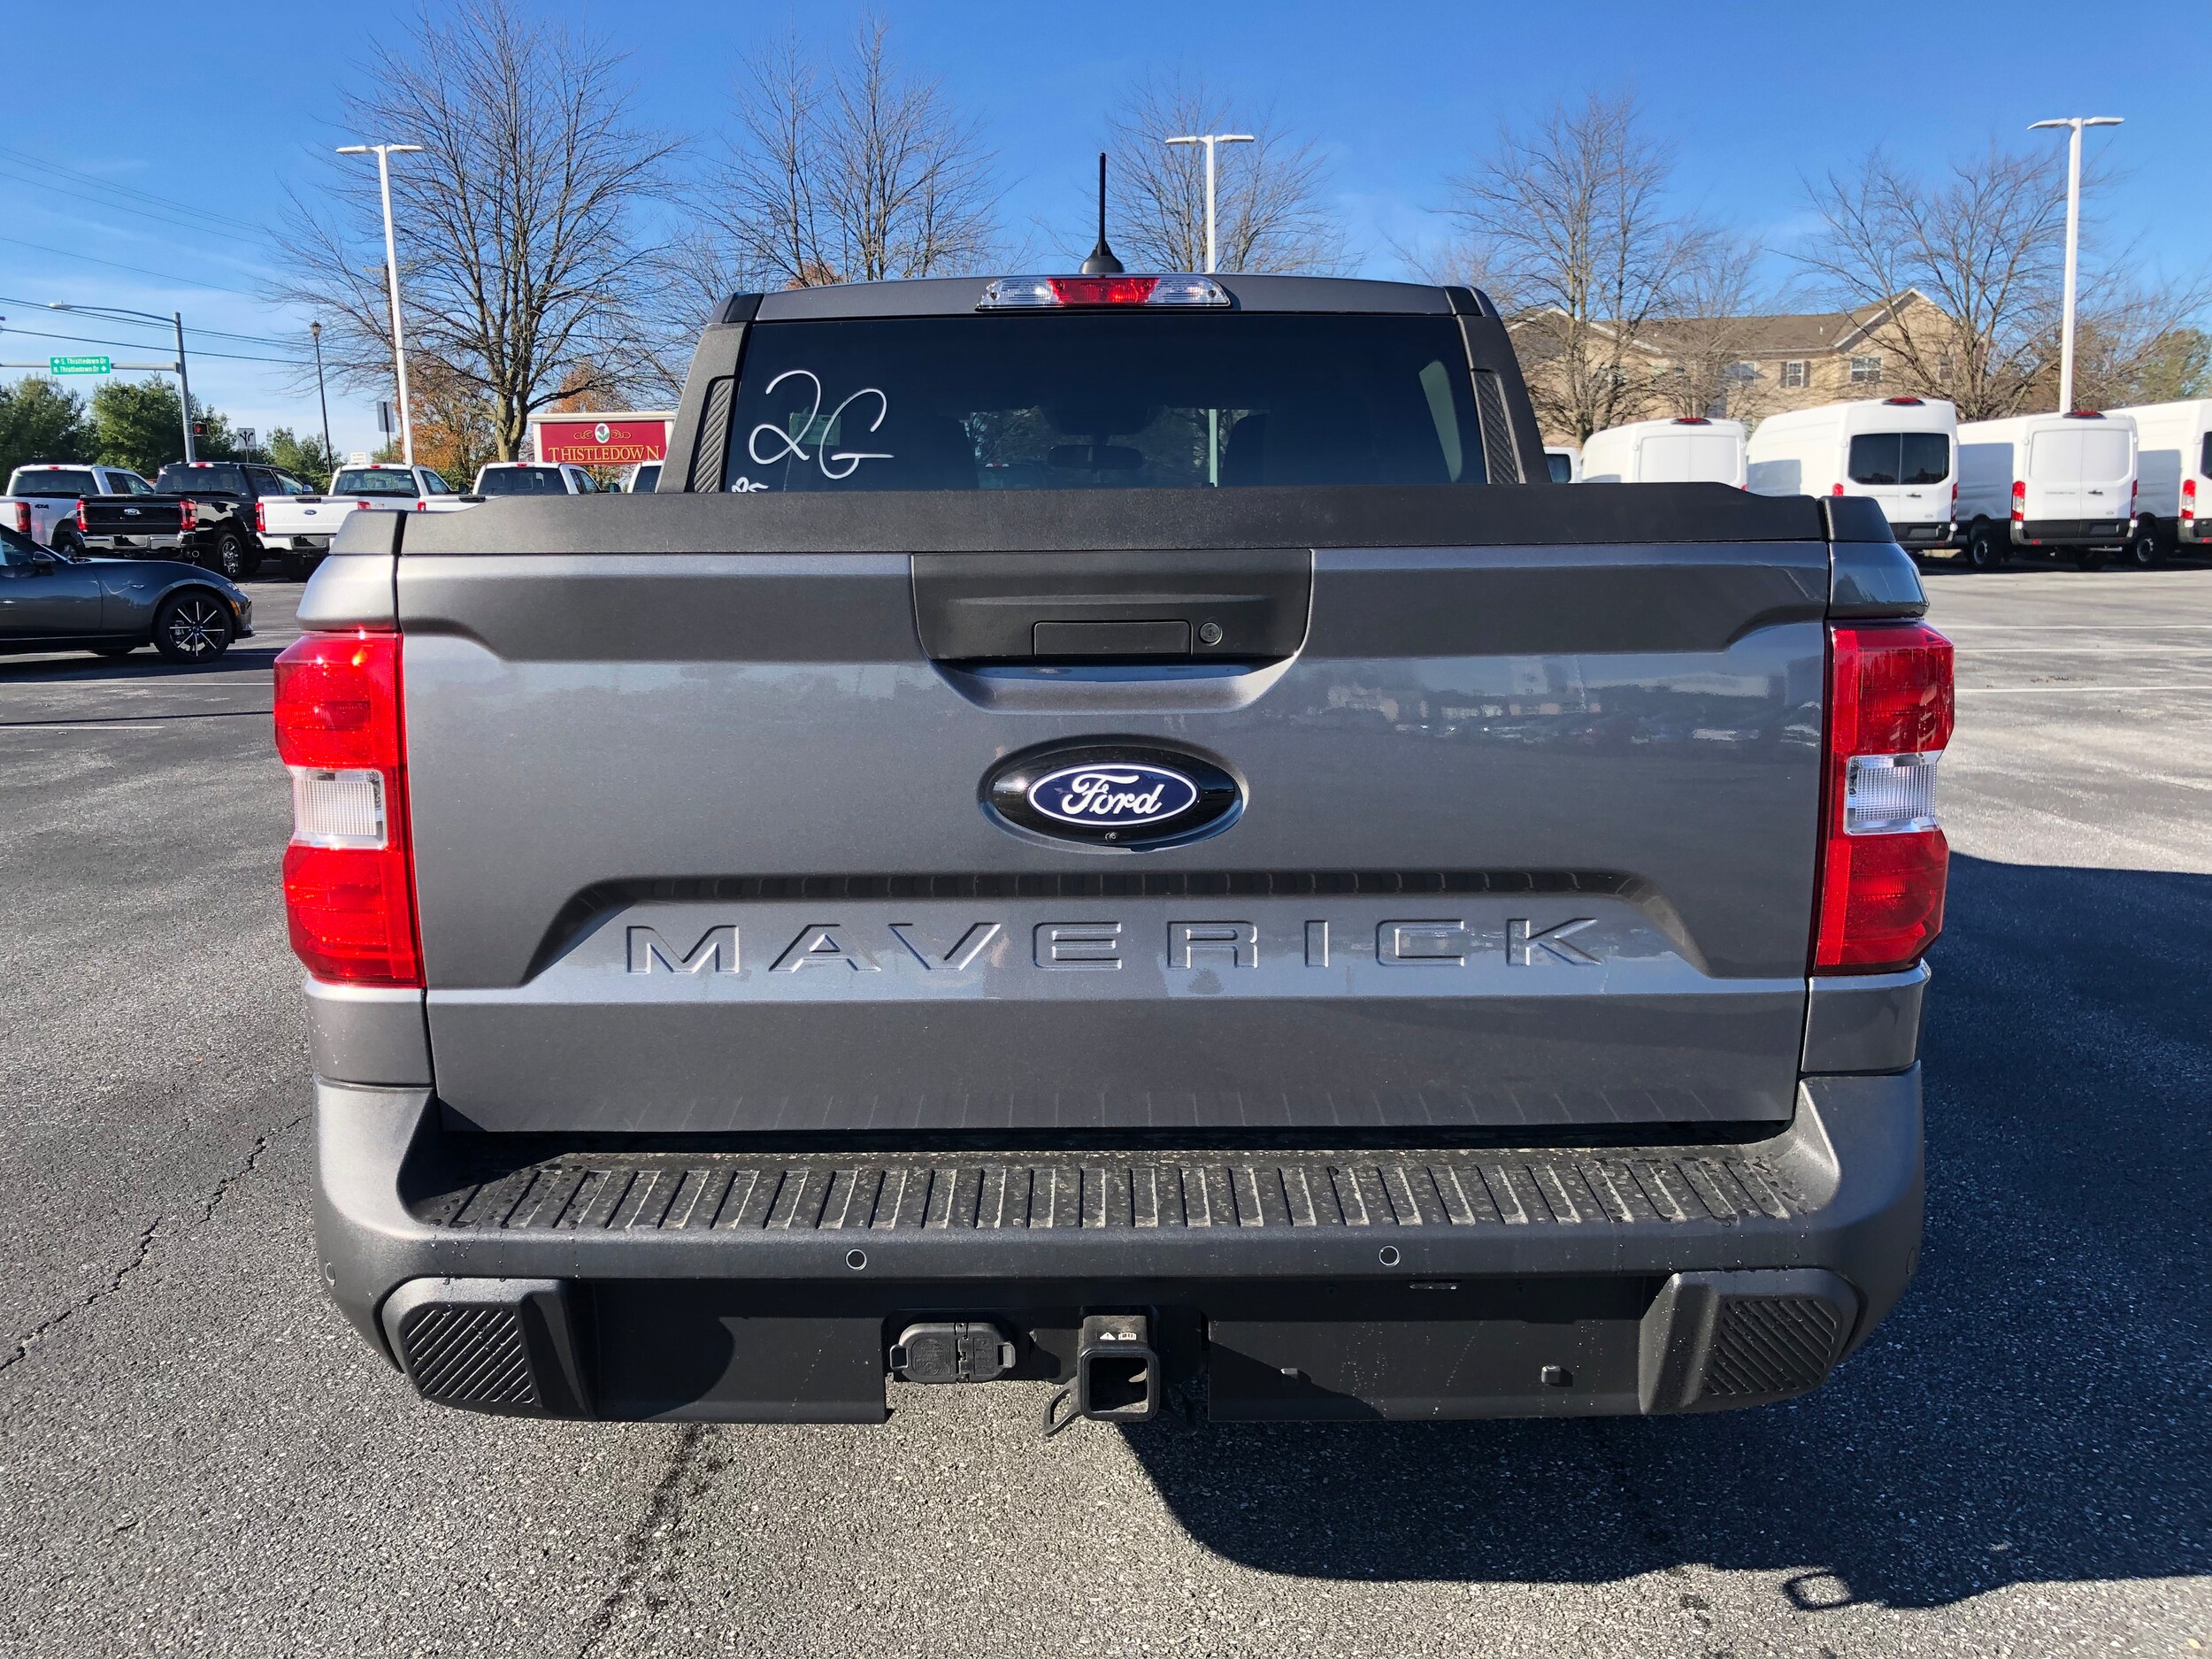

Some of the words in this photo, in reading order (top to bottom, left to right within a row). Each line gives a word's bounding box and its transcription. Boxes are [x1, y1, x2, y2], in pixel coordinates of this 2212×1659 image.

[548, 445, 660, 462] THISTLEDOWN
[1062, 773, 1164, 815] Ford
[626, 918, 1603, 974] MAVERICK
